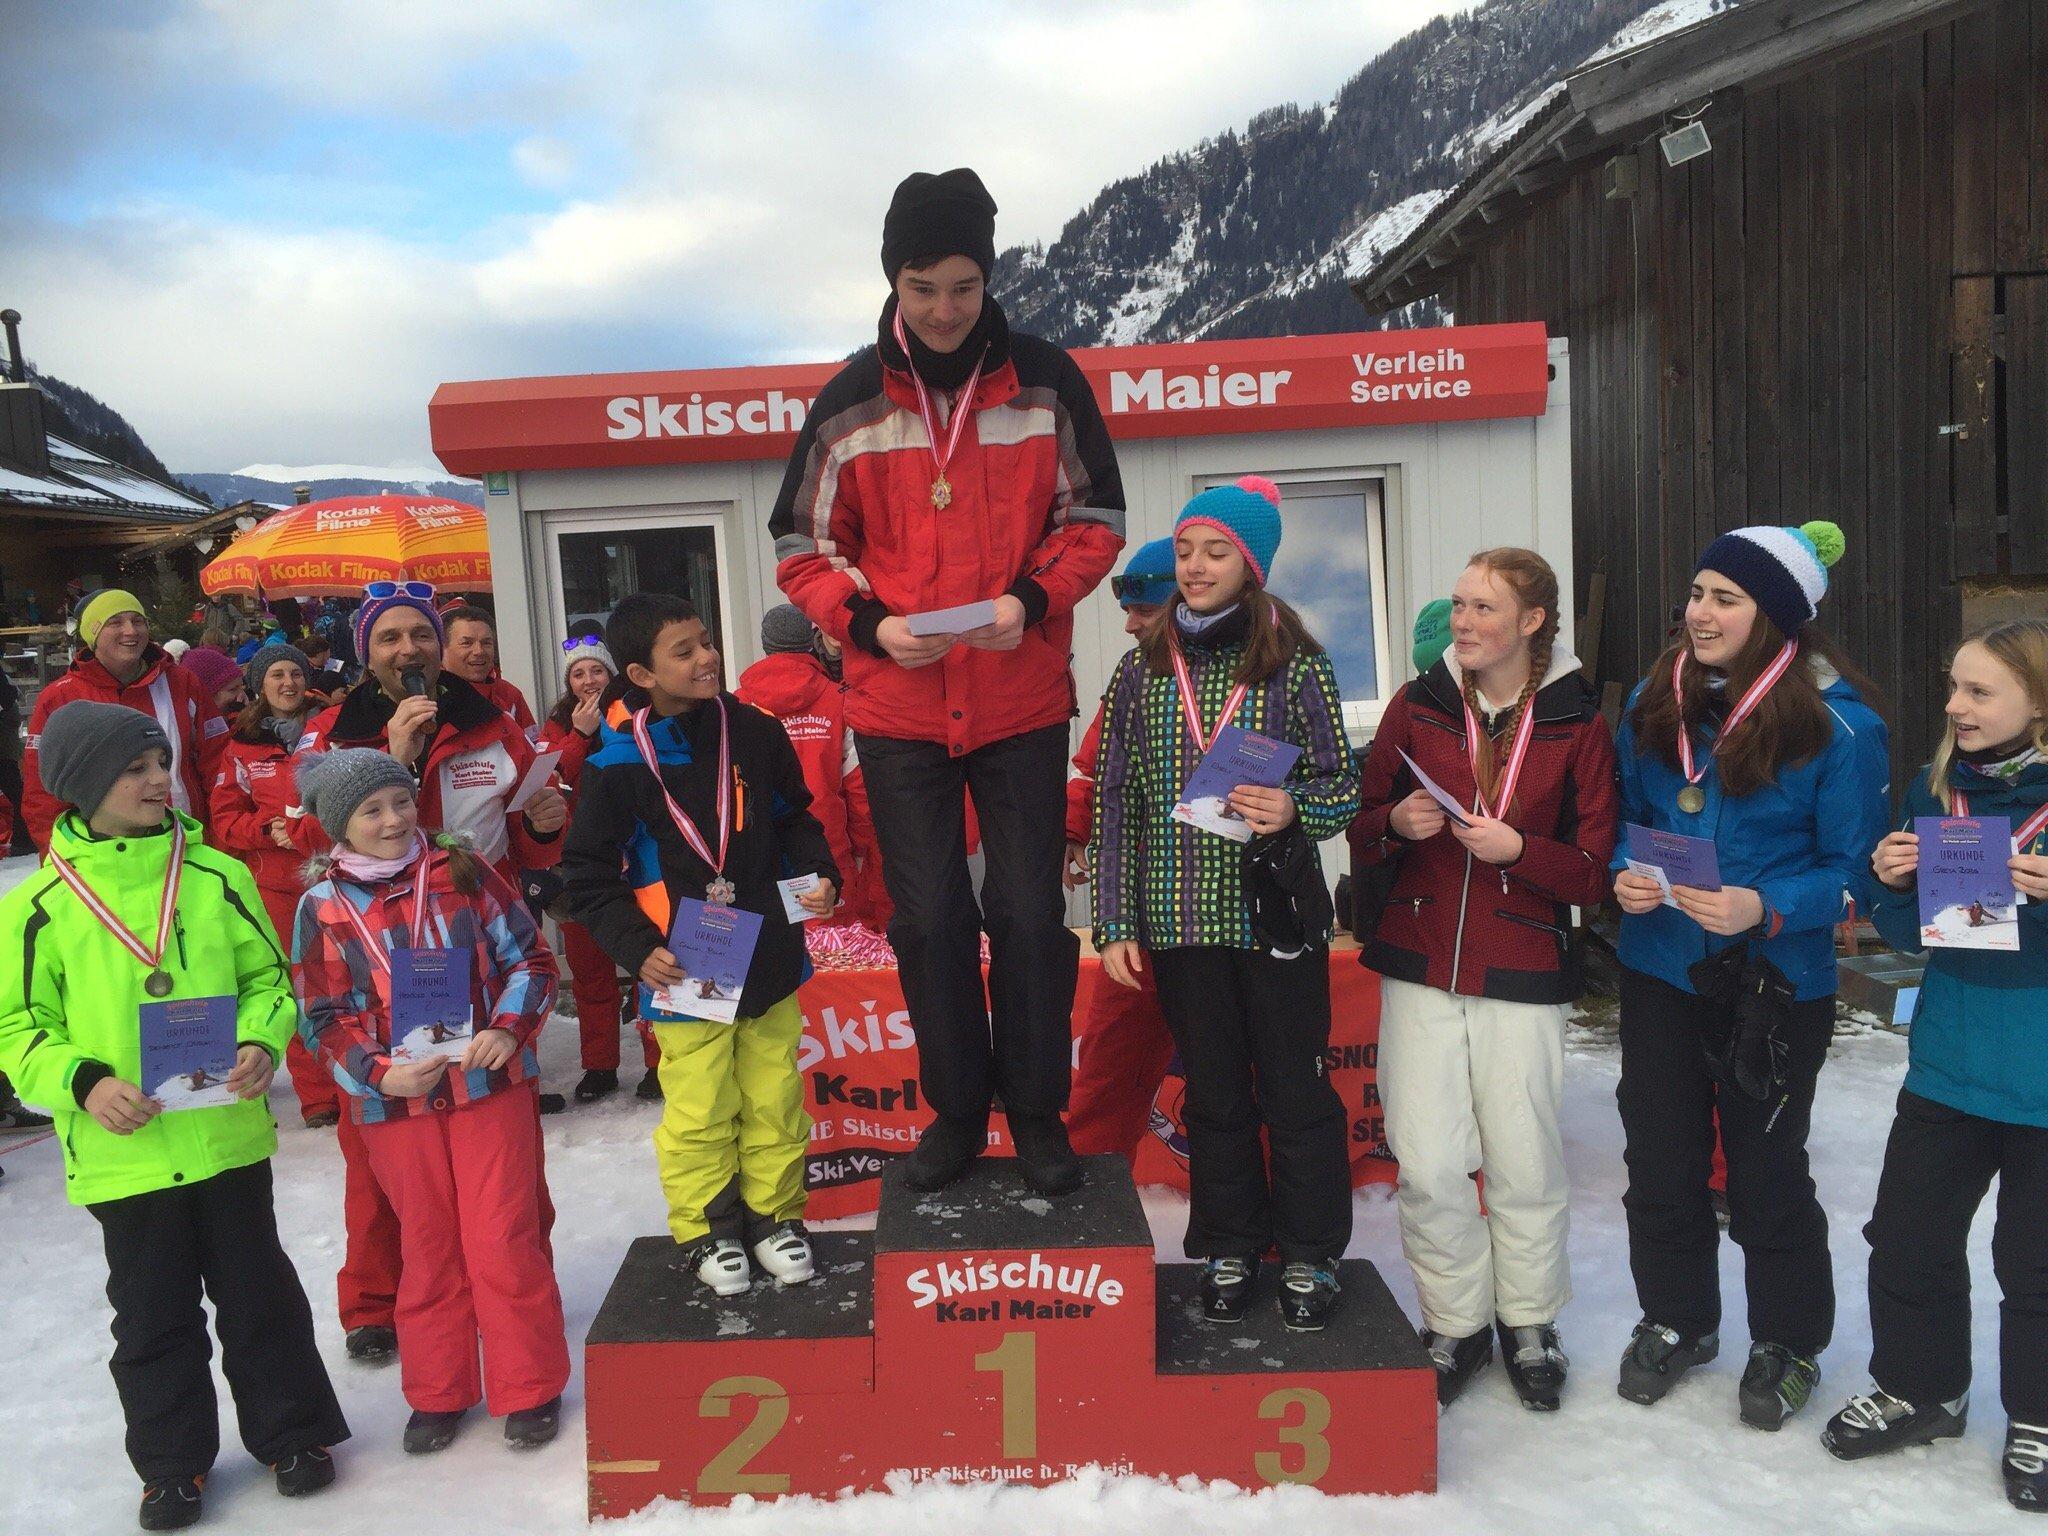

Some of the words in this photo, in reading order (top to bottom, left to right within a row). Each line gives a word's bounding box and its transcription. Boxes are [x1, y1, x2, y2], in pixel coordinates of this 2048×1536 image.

[1351, 348, 1465, 376] Verleih
[606, 390, 817, 440] Skisch
[1109, 364, 1293, 414] Maier
[1350, 377, 1471, 404] Service
[316, 504, 383, 521] Kodak
[405, 503, 460, 518] Kodak
[416, 514, 464, 530] Filme
[316, 517, 372, 533] Filme
[206, 565, 233, 586] Kodak
[269, 561, 335, 581] Kodak
[340, 561, 392, 582] Filme
[413, 559, 471, 581] Kodak
[475, 558, 491, 576] Fi
[781, 714, 832, 728] Skischule
[449, 760, 496, 774] Skischule
[1940, 849, 1984, 861] URKUNDE
[797, 1000, 917, 1072] Skis
[1325, 1043, 1379, 1071] SNO
[812, 1072, 918, 1112] Karl
[1363, 1083, 1381, 1108] R
[842, 1118, 922, 1143] Skisch
[1352, 1117, 1387, 1143] SE
[808, 1155, 887, 1183] Ski-Ve
[906, 1253, 1124, 1309] Skischule
[935, 1300, 1001, 1323] Karl
[1009, 1299, 1096, 1320] Maier
[974, 1331, 1037, 1459] 1
[696, 1375, 791, 1494] 2
[1254, 1387, 1332, 1485] 3
[938, 1463, 1033, 1482] Skischule
[1065, 1461, 1134, 1478] Rris!
